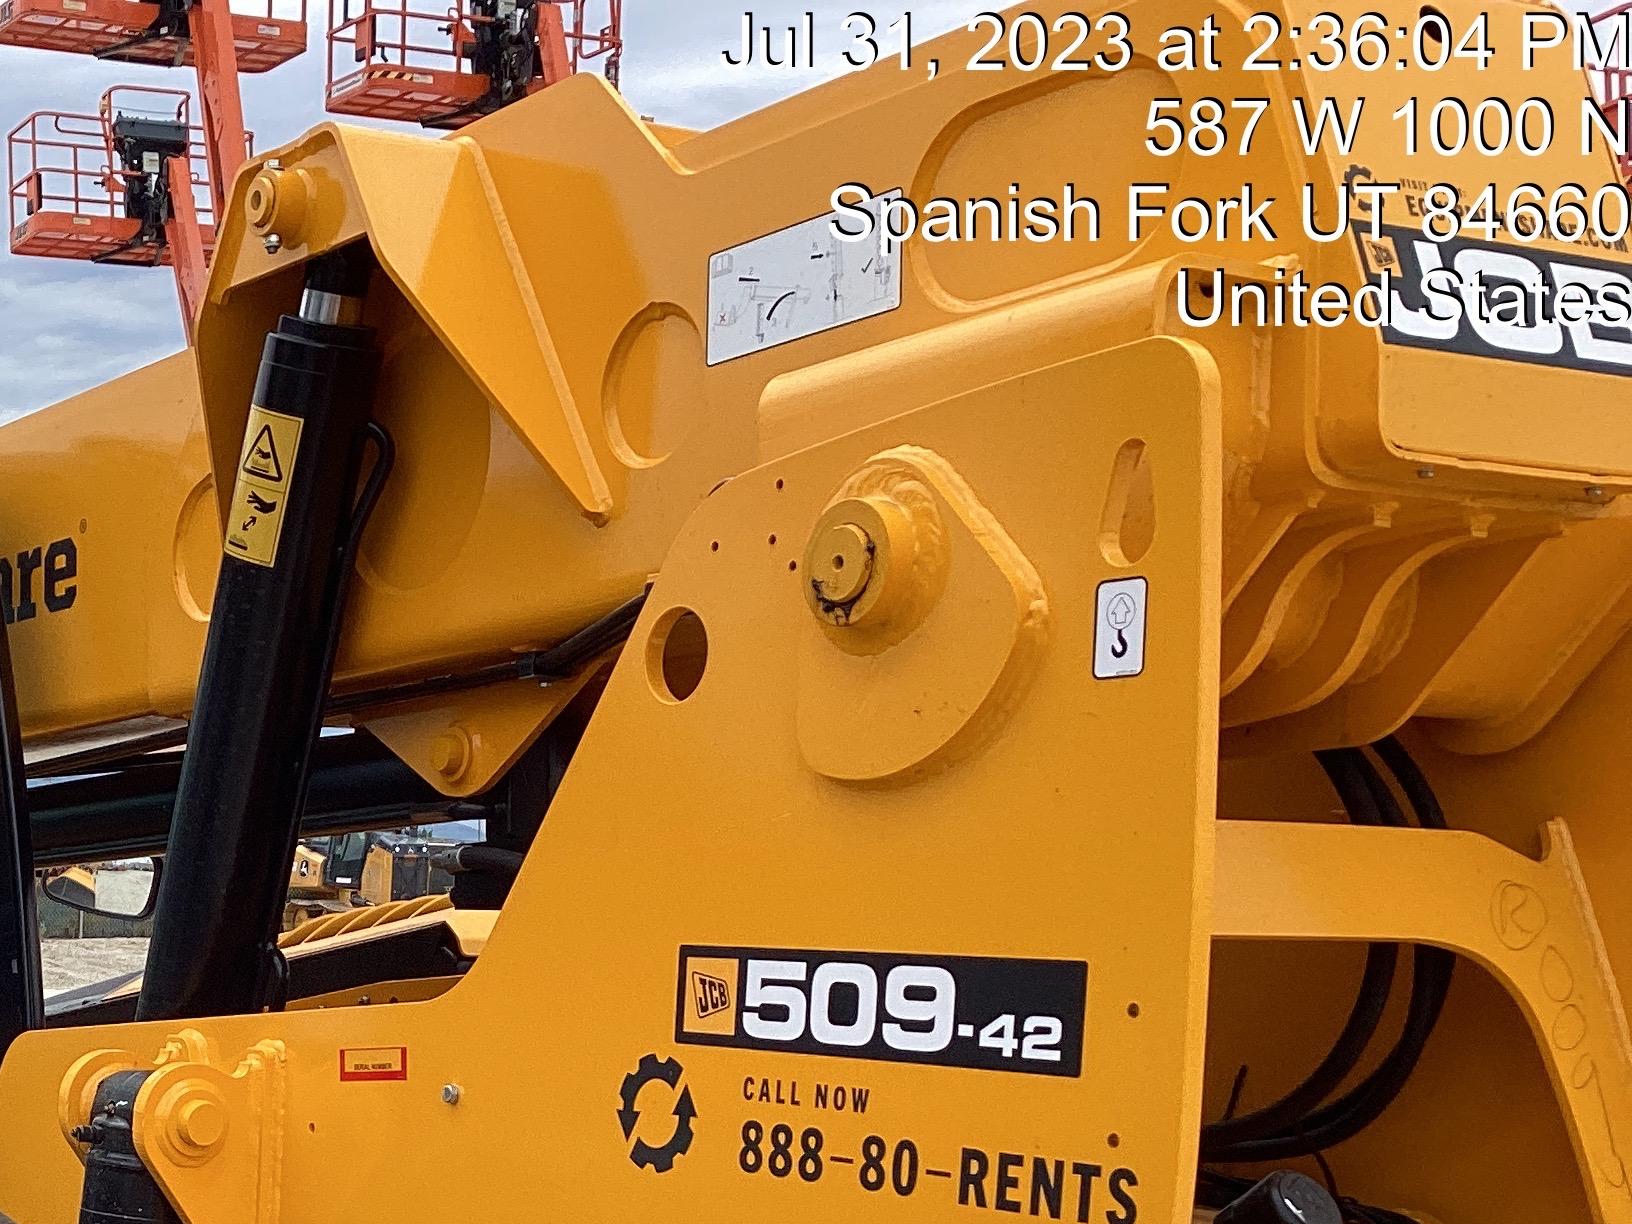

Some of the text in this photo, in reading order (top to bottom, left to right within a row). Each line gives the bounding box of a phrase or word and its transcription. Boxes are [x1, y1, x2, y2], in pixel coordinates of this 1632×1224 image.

[697, 957, 1064, 1062] JCB 509-42
[742, 1076, 870, 1113] CALL NOW
